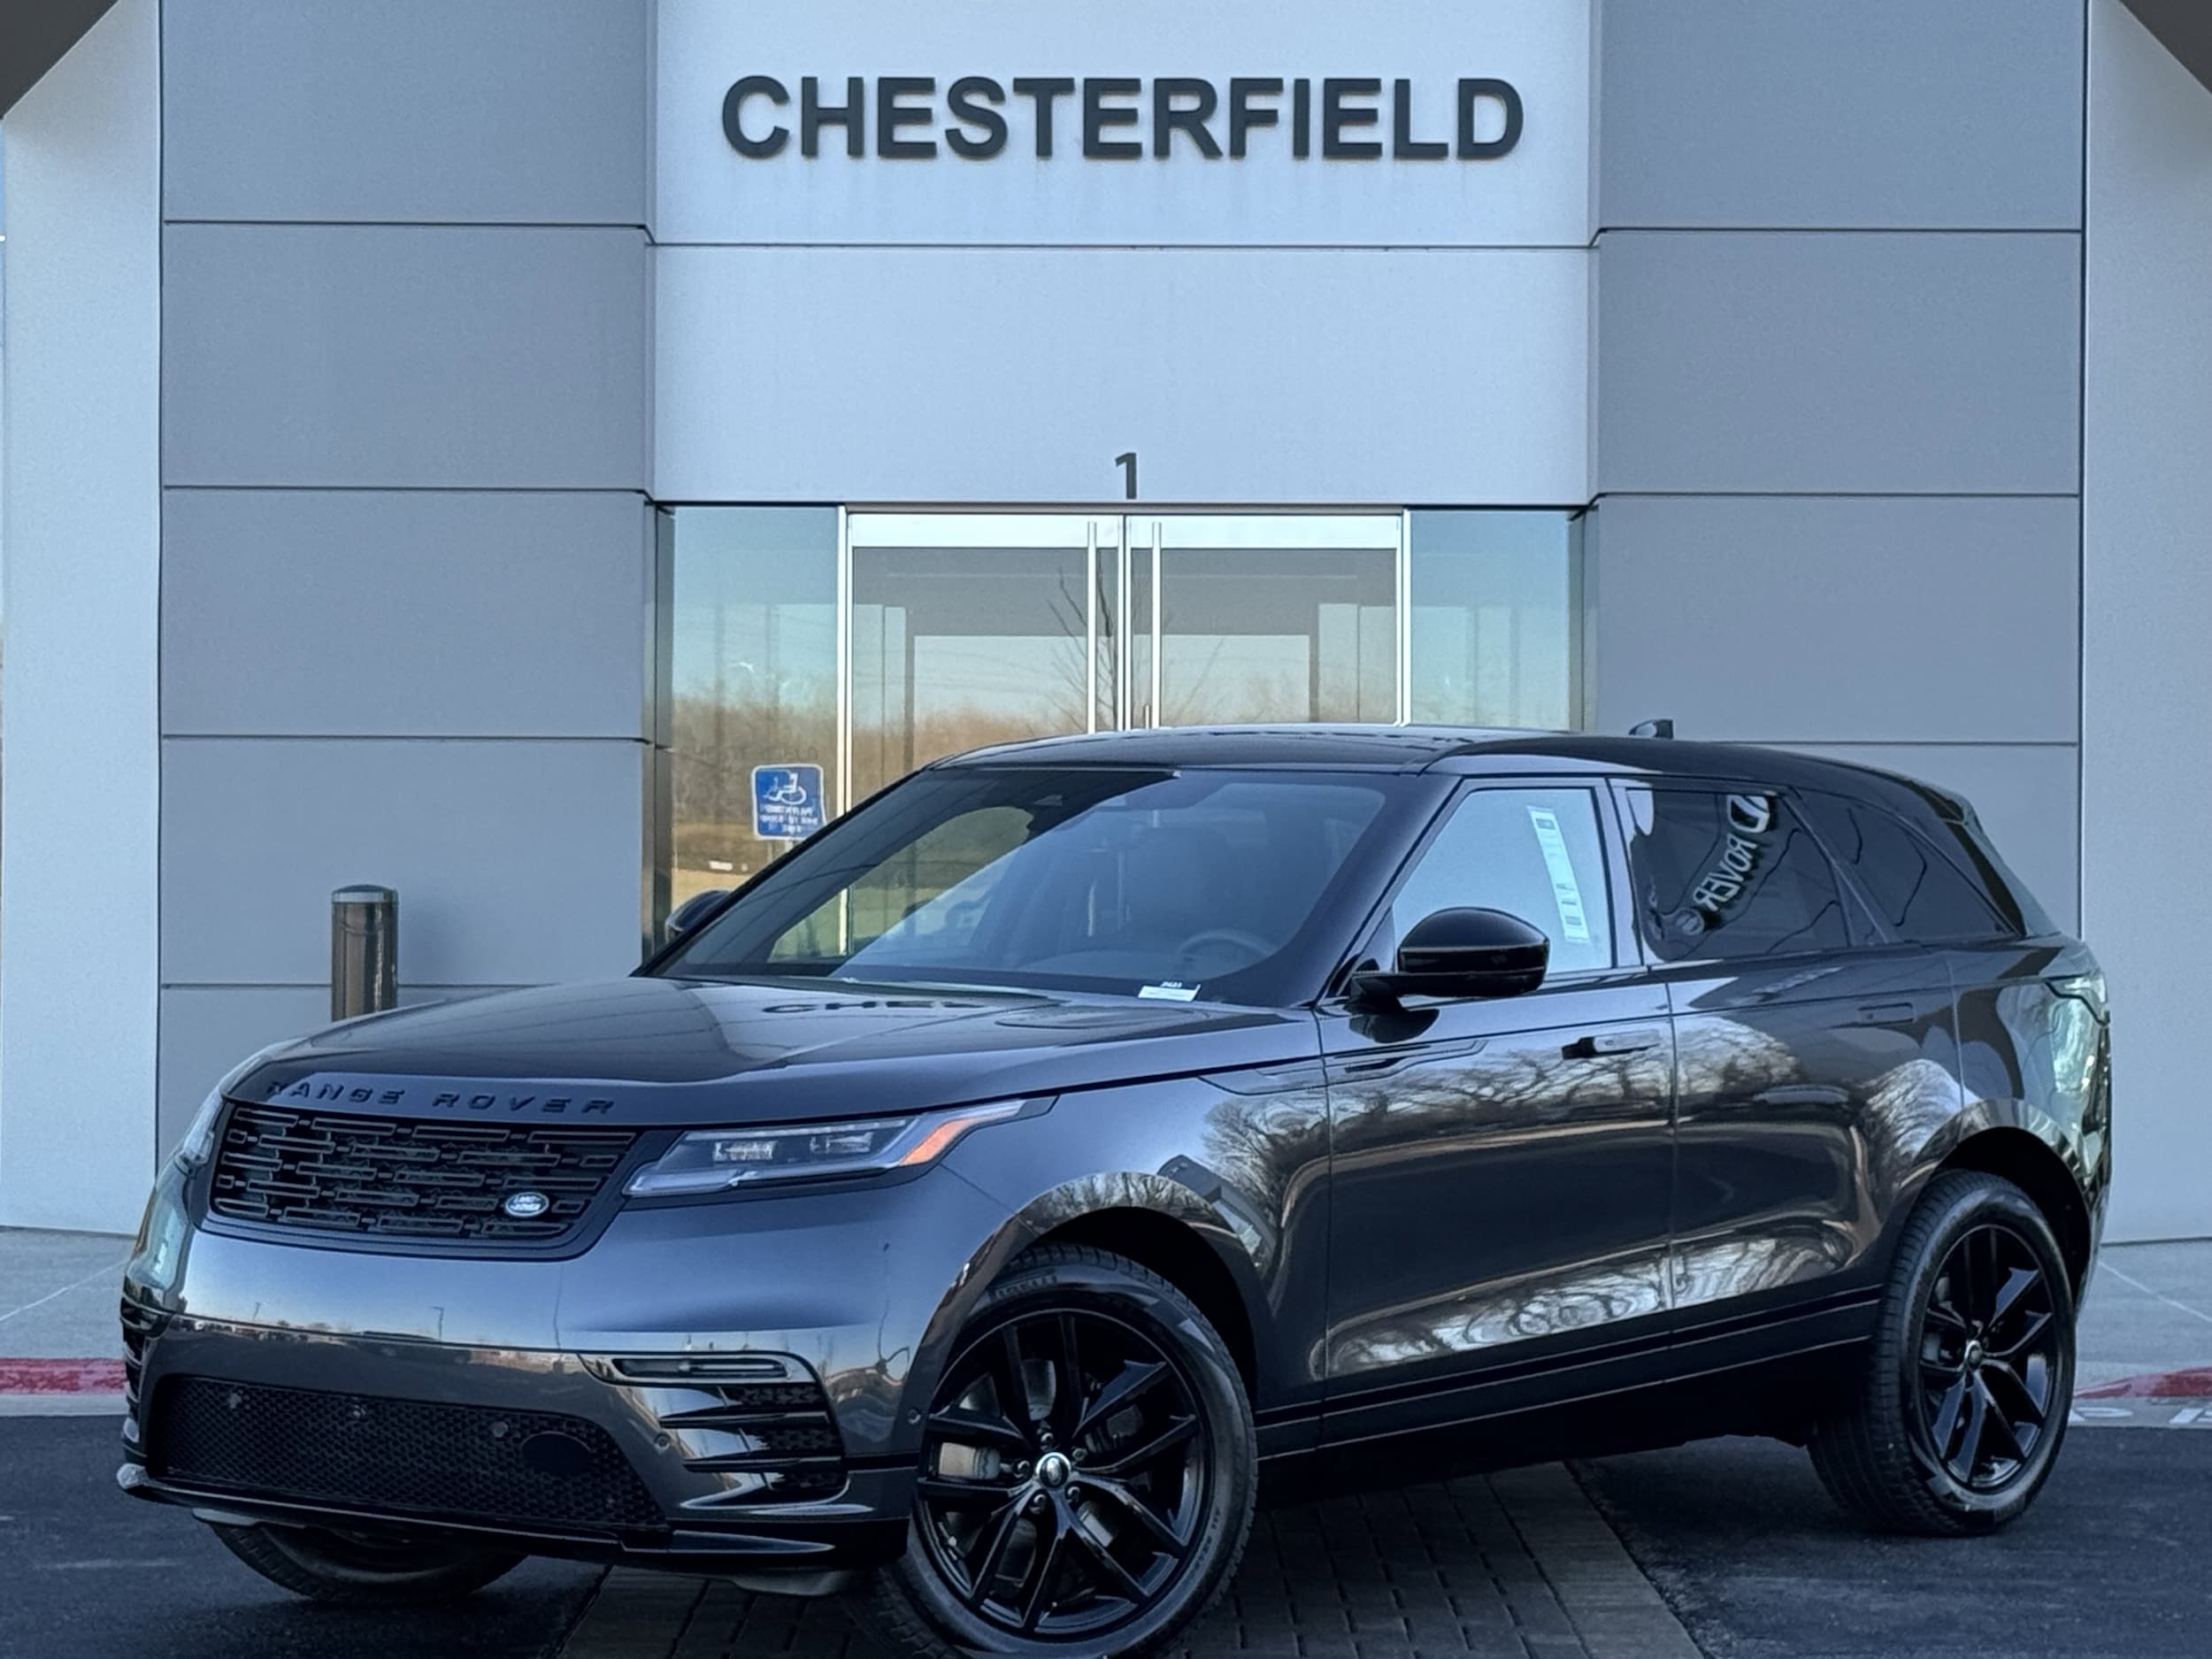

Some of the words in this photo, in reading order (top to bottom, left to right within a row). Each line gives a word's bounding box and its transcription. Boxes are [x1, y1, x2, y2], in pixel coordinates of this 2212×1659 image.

[722, 74, 1525, 160] CHESTERFIELD
[1115, 452, 1138, 500] 1
[265, 1080, 405, 1105] RANGE
[432, 1093, 614, 1115] ROVER
